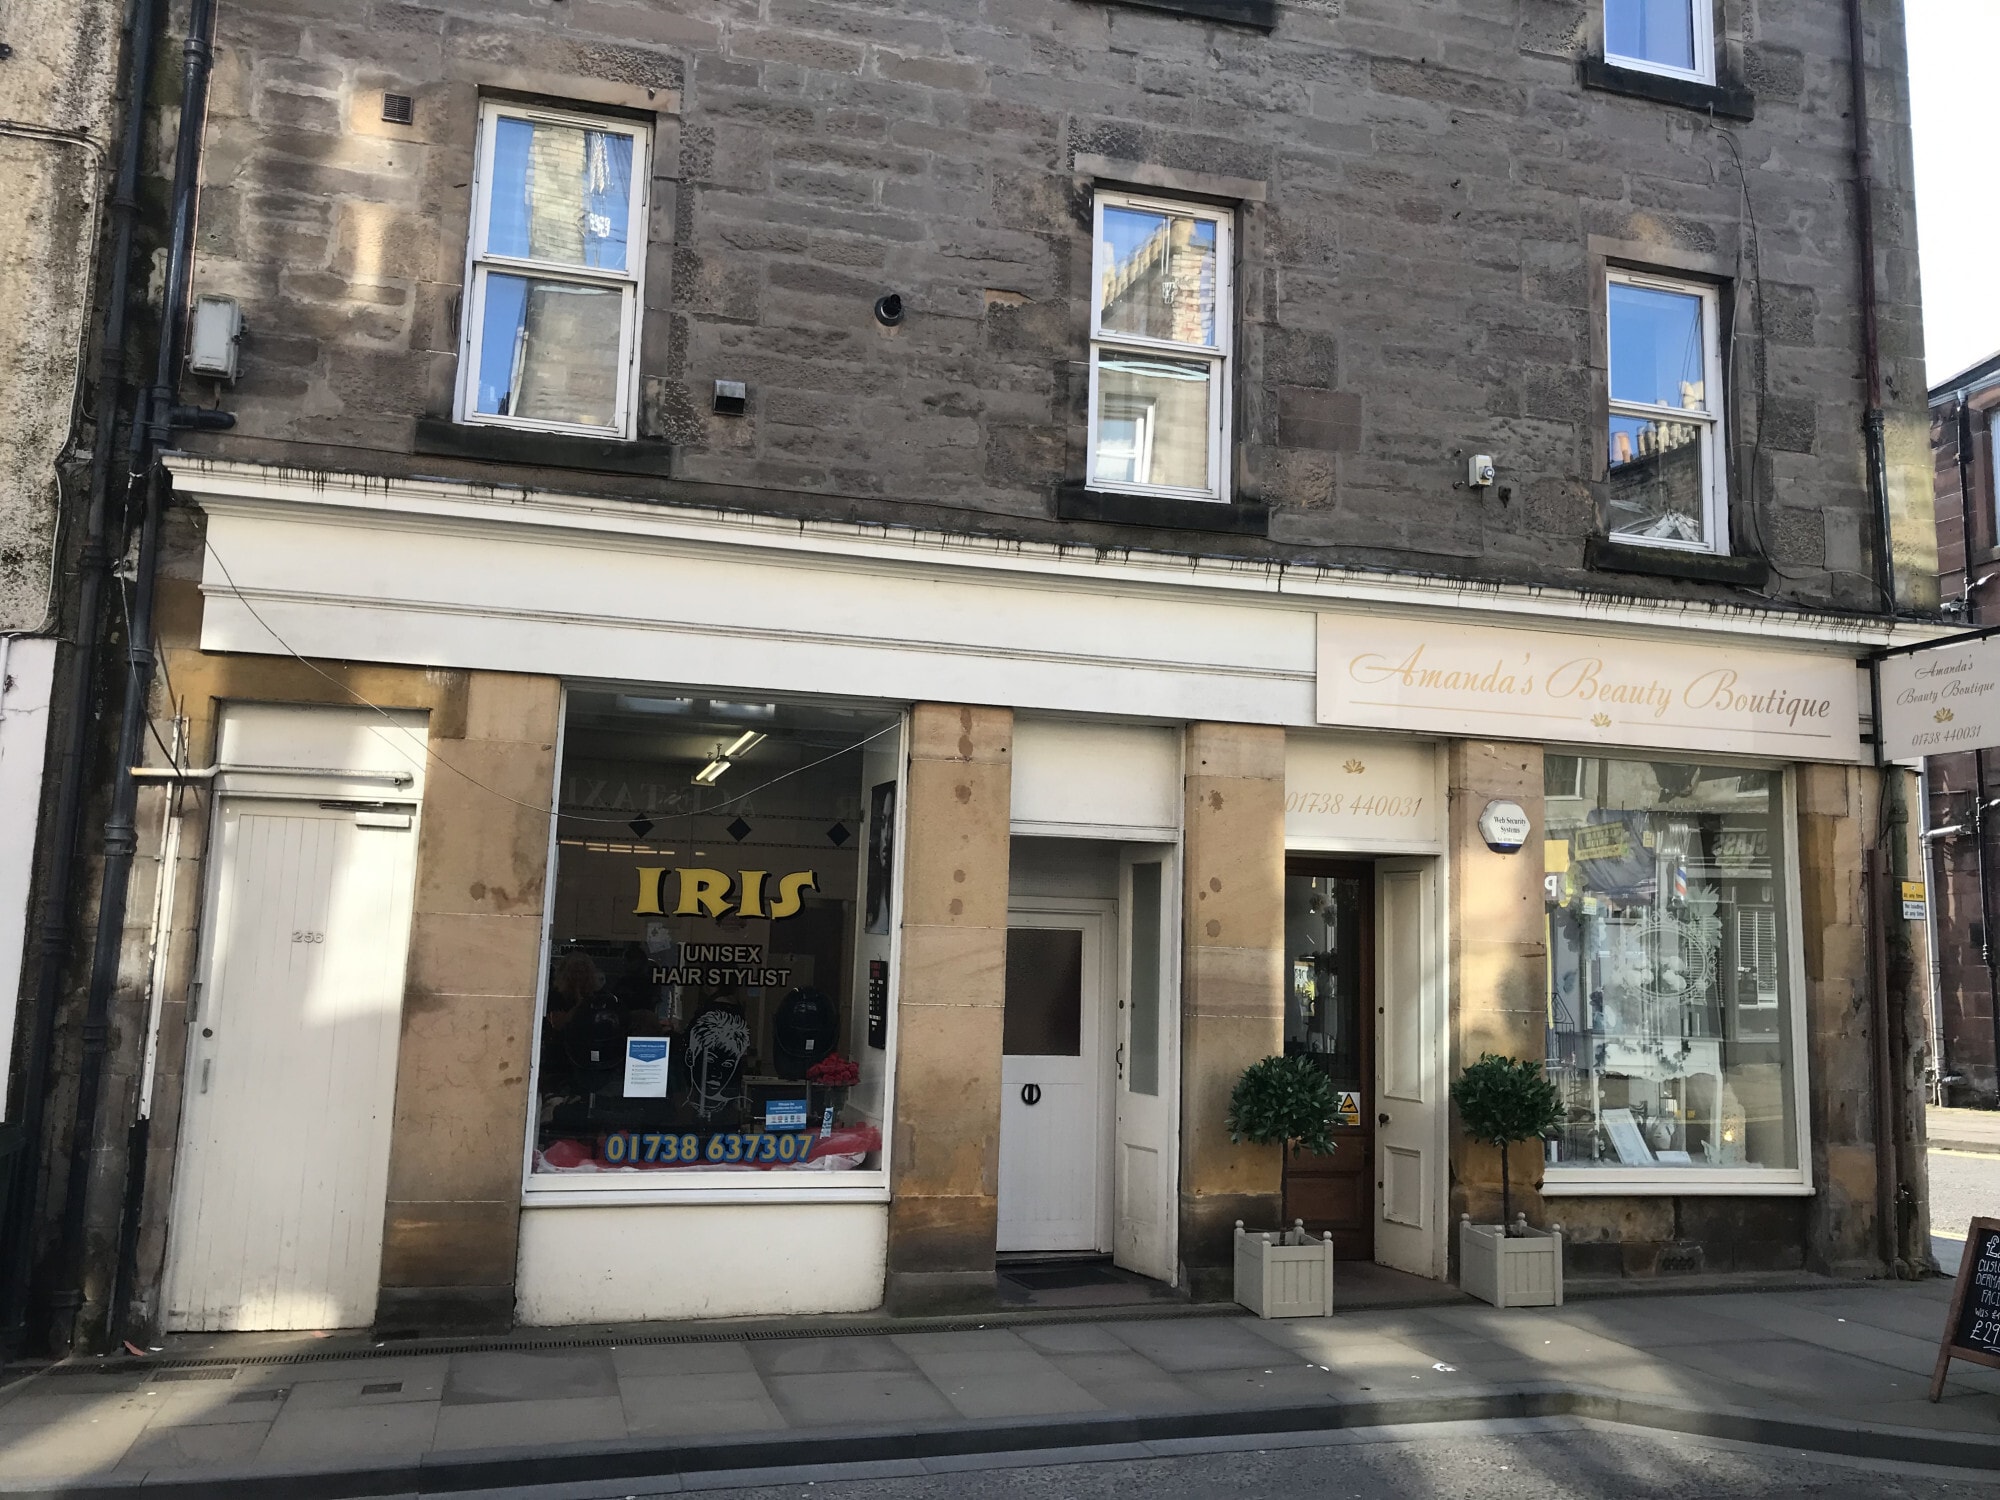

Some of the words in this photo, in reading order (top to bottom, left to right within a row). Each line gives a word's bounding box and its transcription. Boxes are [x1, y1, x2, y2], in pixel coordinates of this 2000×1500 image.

[1914, 653, 1974, 680] Amanda's
[1348, 643, 1534, 697] Amanda's
[1545, 657, 1672, 718] Beauty
[1682, 668, 1831, 728] Boutique
[1896, 687, 1938, 706] Beauty
[1941, 679, 1995, 698] Boutique
[1911, 731, 1941, 746] 01738
[1943, 725, 1982, 742] 440031
[1285, 791, 1344, 815] 01738
[1349, 795, 1423, 818] 440031
[632, 866, 820, 921] IRIS
[685, 945, 762, 964] UNISEX
[652, 967, 702, 985] HAIR
[708, 969, 790, 986] STYLIST
[606, 1133, 698, 1163] 01738
[705, 1133, 815, 1163] 637307
